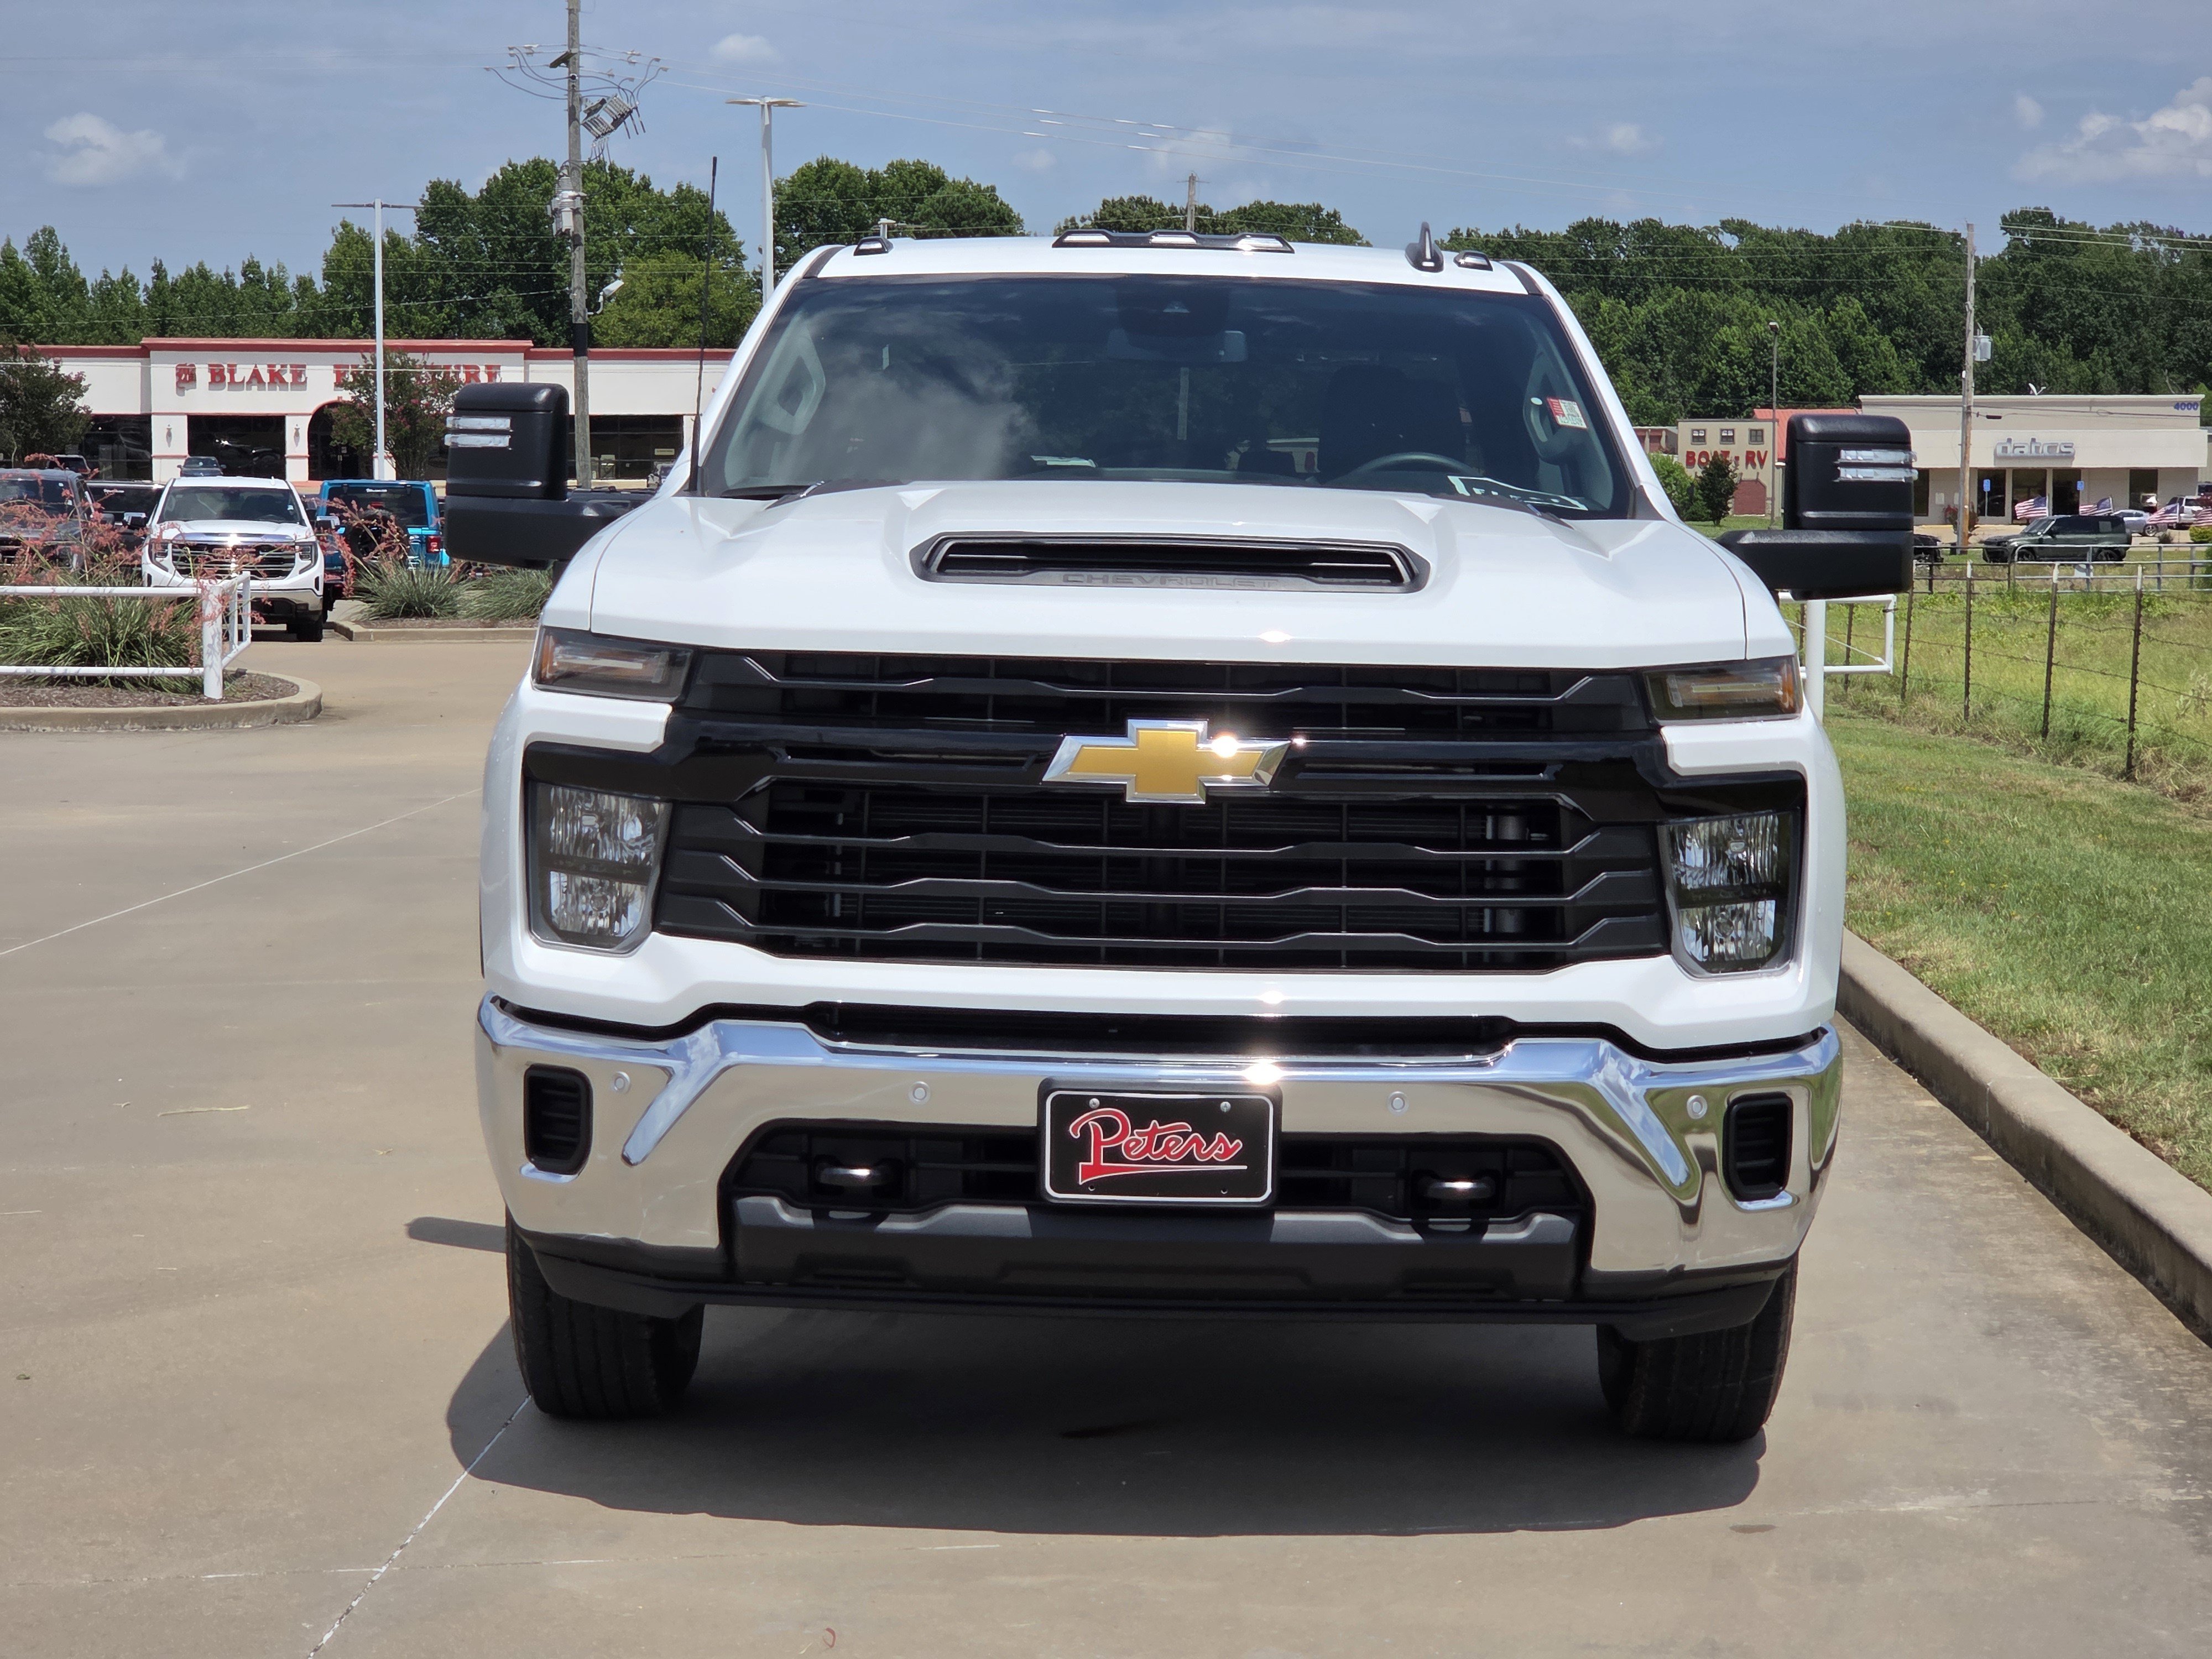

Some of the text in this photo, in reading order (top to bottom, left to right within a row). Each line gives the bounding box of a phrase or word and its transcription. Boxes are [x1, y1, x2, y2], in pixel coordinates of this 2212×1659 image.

[208, 364, 307, 384] BLAKE
[2173, 402, 2199, 410] 4000
[1745, 450, 1768, 468] RV
[1062, 573, 1279, 588] CHEVROLET
[1070, 1108, 1244, 1185] Peters
